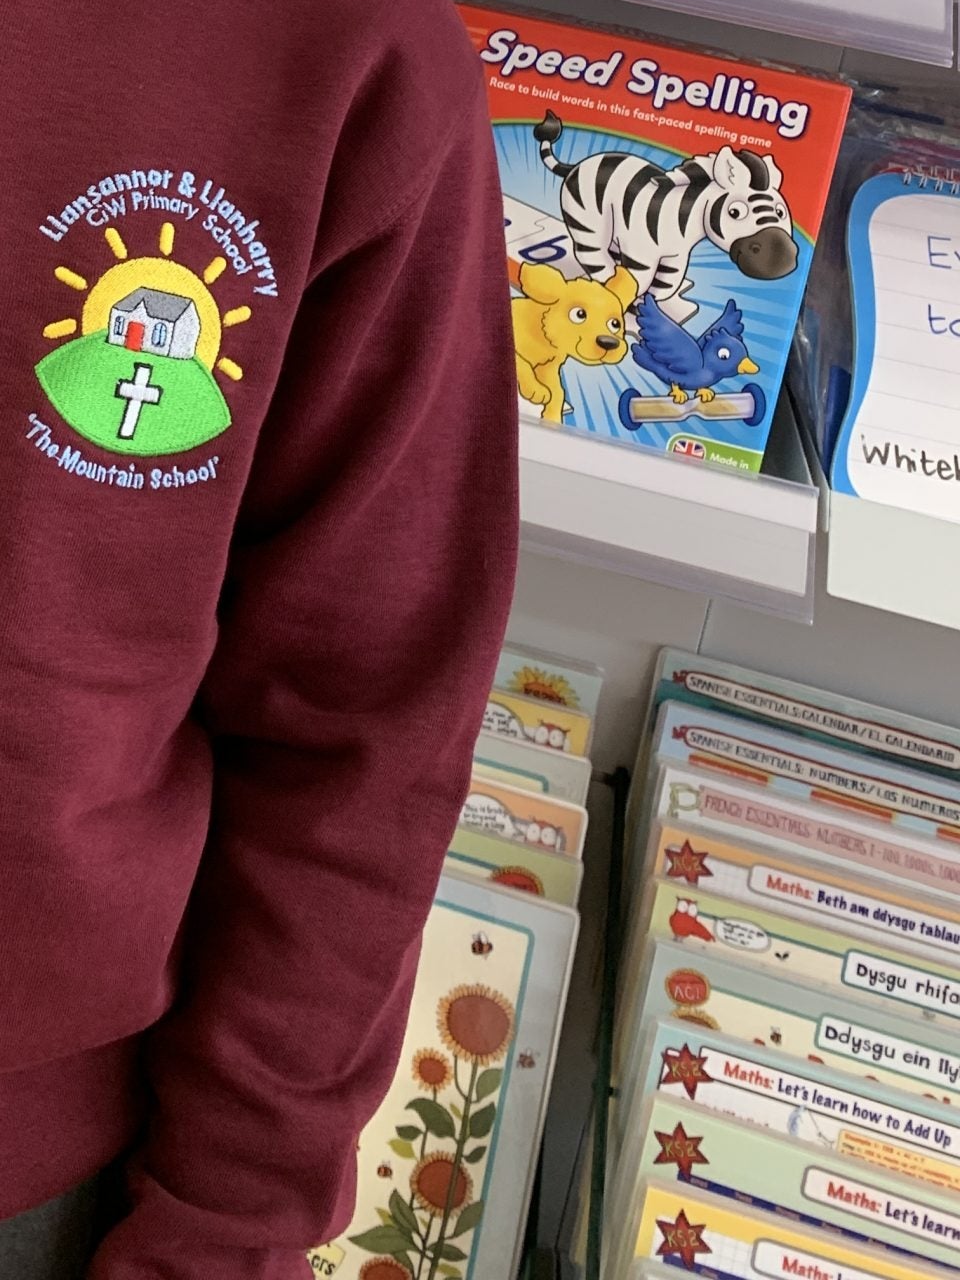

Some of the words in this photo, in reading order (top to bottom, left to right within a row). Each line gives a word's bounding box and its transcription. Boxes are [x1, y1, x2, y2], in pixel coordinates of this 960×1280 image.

[479, 28, 623, 88] Speed
[627, 58, 810, 139] Spelling
[490, 76, 516, 92] Race
[518, 84, 529, 95] to
[532, 87, 559, 102] build
[561, 94, 595, 109] words
[597, 100, 607, 112] in
[610, 103, 630, 117] this
[633, 108, 692, 131] fast-paced
[695, 123, 737, 144] spelling
[740, 134, 772, 149] game
[39, 169, 173, 242] Llansannor
[178, 171, 196, 199] &
[199, 180, 278, 297] Llanharry
[132, 190, 199, 220] Primary
[202, 214, 253, 275] School
[57, 451, 144, 489] Mountain
[709, 452, 738, 468] Made
[766, 874, 814, 900] Maths:
[816, 889, 847, 910] Beth
[850, 902, 869, 917] am
[872, 907, 916, 933] ddysgu
[855, 963, 907, 991] Dysgu
[825, 1025, 895, 1061] Ddysgu
[903, 1051, 930, 1069] ein
[724, 1061, 774, 1090] Maths:
[778, 1078, 809, 1102] Let's
[812, 1090, 848, 1113] learn
[852, 1104, 882, 1123] how
[885, 1115, 900, 1130] to
[904, 1120, 930, 1140] Add
[934, 1128, 952, 1148] Up
[827, 1181, 882, 1213] Maths:
[885, 1202, 918, 1226] Let's
